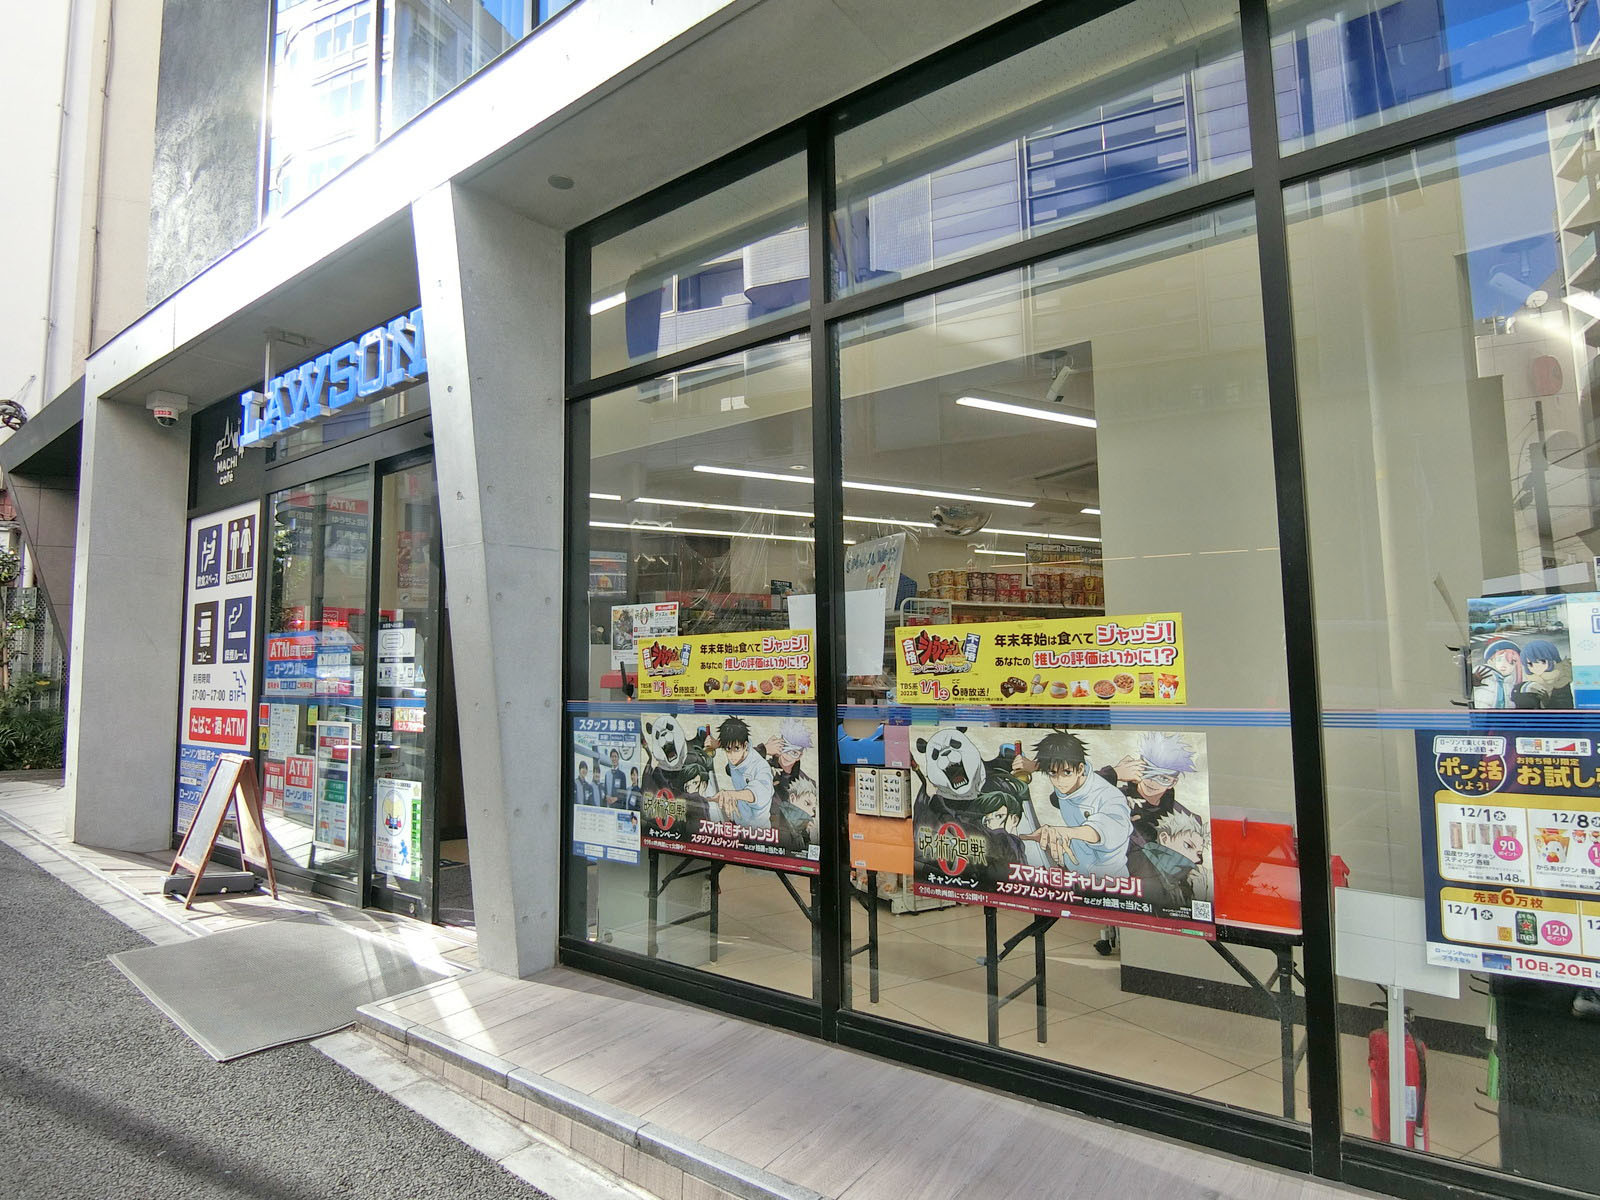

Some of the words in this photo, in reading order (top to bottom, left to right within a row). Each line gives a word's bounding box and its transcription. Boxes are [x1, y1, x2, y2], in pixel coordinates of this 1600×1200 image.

[239, 306, 428, 447] LAWSON
[217, 455, 238, 473] MACHI
[219, 470, 234, 485] café
[329, 499, 356, 511] ATM
[197, 651, 211, 662] コピー
[902, 637, 918, 666] 合格
[900, 682, 918, 690] TBS系
[952, 684, 990, 697] 6時放送!
[579, 719, 635, 732] スタッフ募集中
[288, 759, 310, 777] ATM
[1439, 756, 1503, 781] ポン活
[1516, 765, 1600, 788] お試し
[1455, 781, 1490, 791] しよう!
[649, 828, 682, 840] キャンペーン
[699, 820, 779, 843] スマホでチャレンジ!
[919, 833, 988, 866] 呪術廻戦
[1499, 840, 1516, 851] 90
[1536, 864, 1578, 873] からあげクン
[928, 872, 979, 888] キャンペーン
[1008, 863, 1142, 897] スマホでチャレンジ!
[918, 885, 989, 903] 全国の映画館にて公開中!
[1474, 889, 1544, 908] 先着6万枚
[1545, 924, 1569, 936] 120
